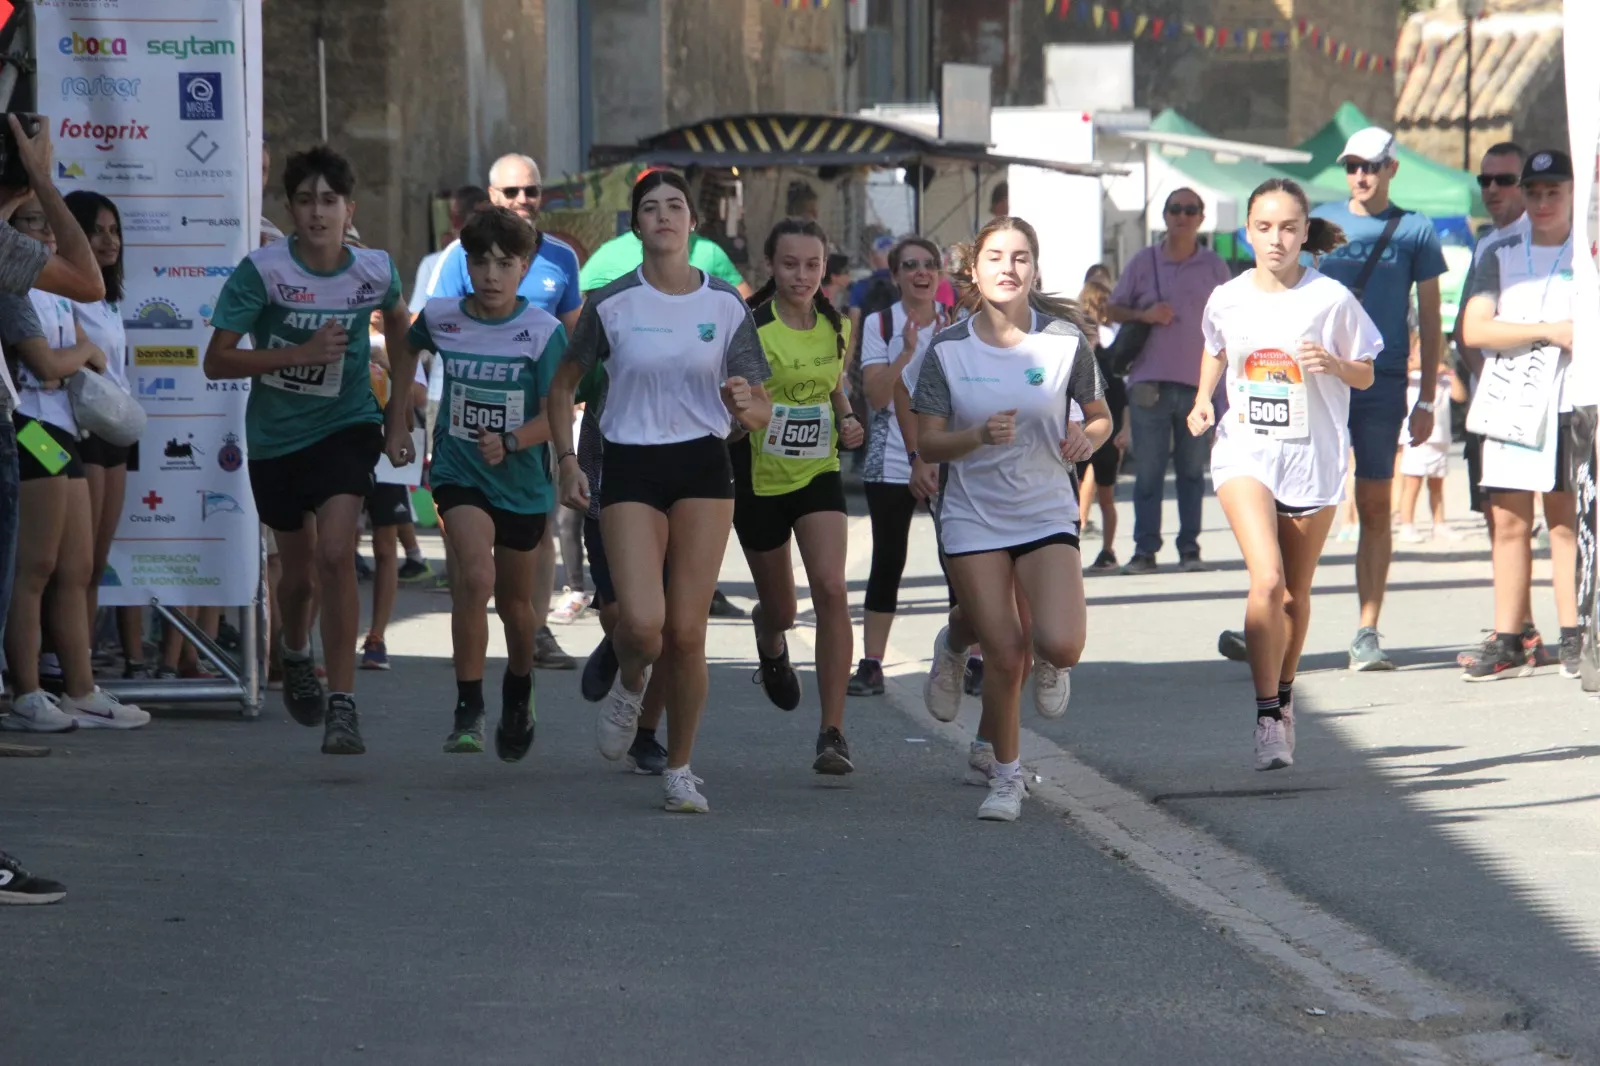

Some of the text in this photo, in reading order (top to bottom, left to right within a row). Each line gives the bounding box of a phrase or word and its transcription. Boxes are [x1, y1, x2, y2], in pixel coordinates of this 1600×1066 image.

[58, 32, 127, 56] eboca
[147, 34, 235, 59] seytam
[61, 74, 141, 97] raster
[186, 101, 216, 113] MIGUEL
[59, 117, 150, 144] fotoprix
[174, 169, 233, 178] CUARZOS
[446, 358, 526, 382] ATLEET
[465, 405, 504, 429] 505
[1250, 401, 1288, 423] 506
[784, 424, 818, 443] 502
[129, 514, 176, 524] Cruz Roja
